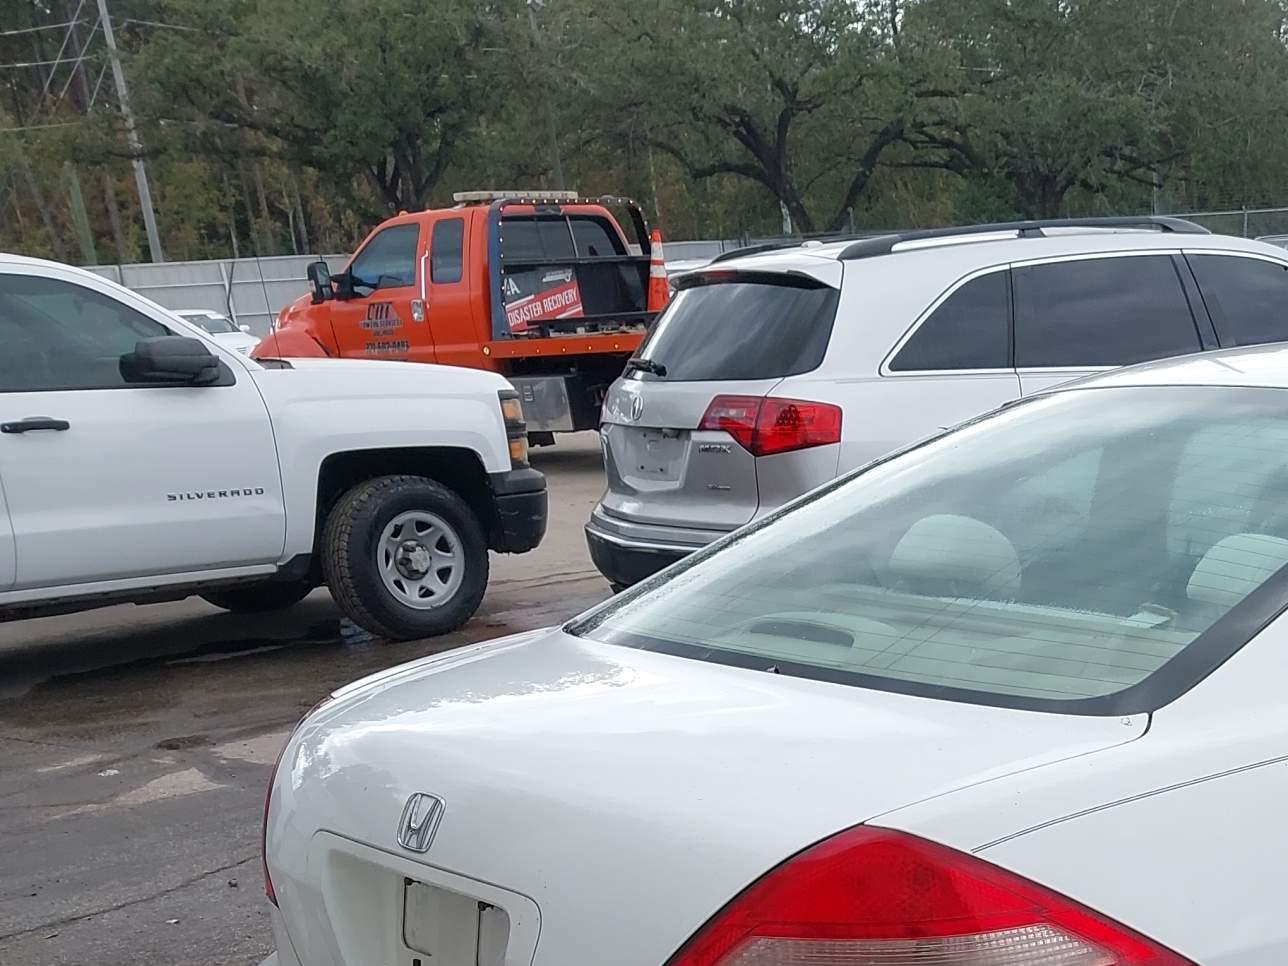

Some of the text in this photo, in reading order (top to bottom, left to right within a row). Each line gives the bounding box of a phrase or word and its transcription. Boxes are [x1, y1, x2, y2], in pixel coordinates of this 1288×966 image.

[507, 287, 578, 327] DISASTER RECOVERY
[167, 487, 265, 502] SILVERADO
